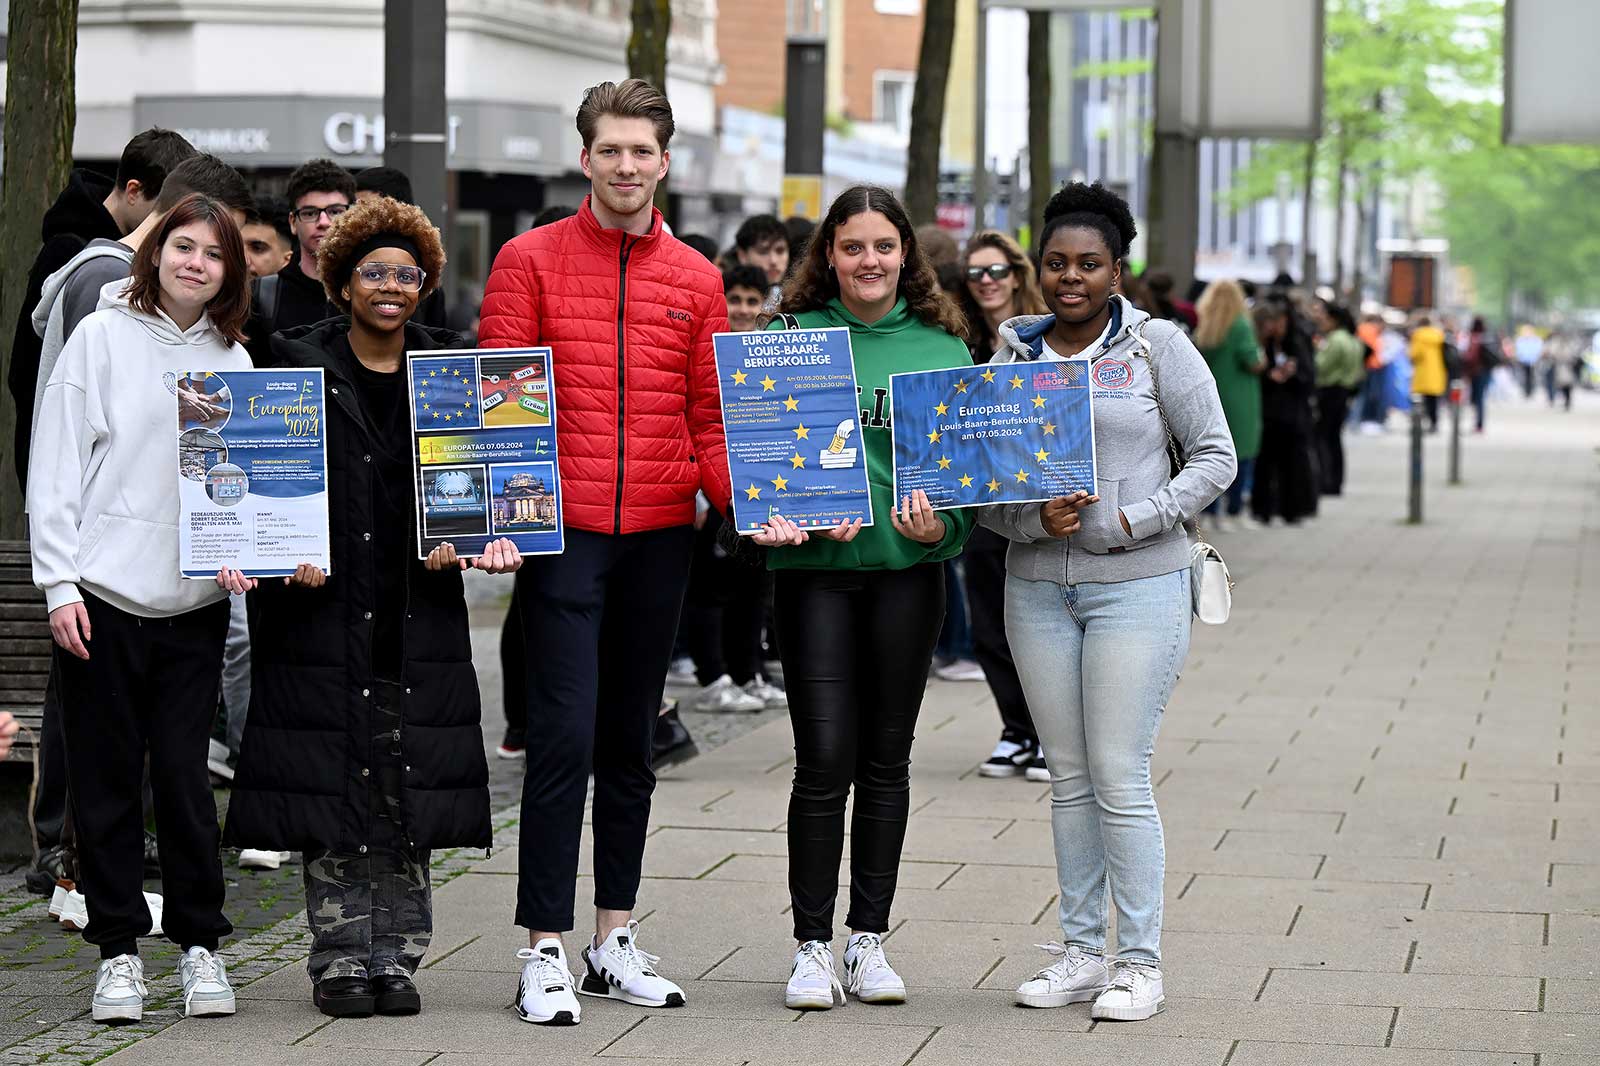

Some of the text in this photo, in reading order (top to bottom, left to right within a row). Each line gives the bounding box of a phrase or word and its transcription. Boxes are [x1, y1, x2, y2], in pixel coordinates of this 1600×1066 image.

[666, 308, 691, 322] HUGO
[741, 333, 827, 346] EUROPATAG AM
[748, 344, 823, 357] LOUIS-BAARE-
[743, 354, 831, 368] BERUFSKOLLEGE
[518, 368, 532, 377] SPD
[1033, 378, 1069, 387] EUROPE
[484, 395, 501, 407] CDU
[524, 399, 544, 411] Grüne
[247, 393, 318, 425] Europatag
[959, 402, 1020, 417] Europatag
[286, 418, 319, 437] 2024
[940, 416, 1044, 431] Louis-Baare-Berufskolleg
[961, 427, 1023, 440] am 07.05.2024
[443, 442, 523, 452] EUROPATAG 07.05.2024
